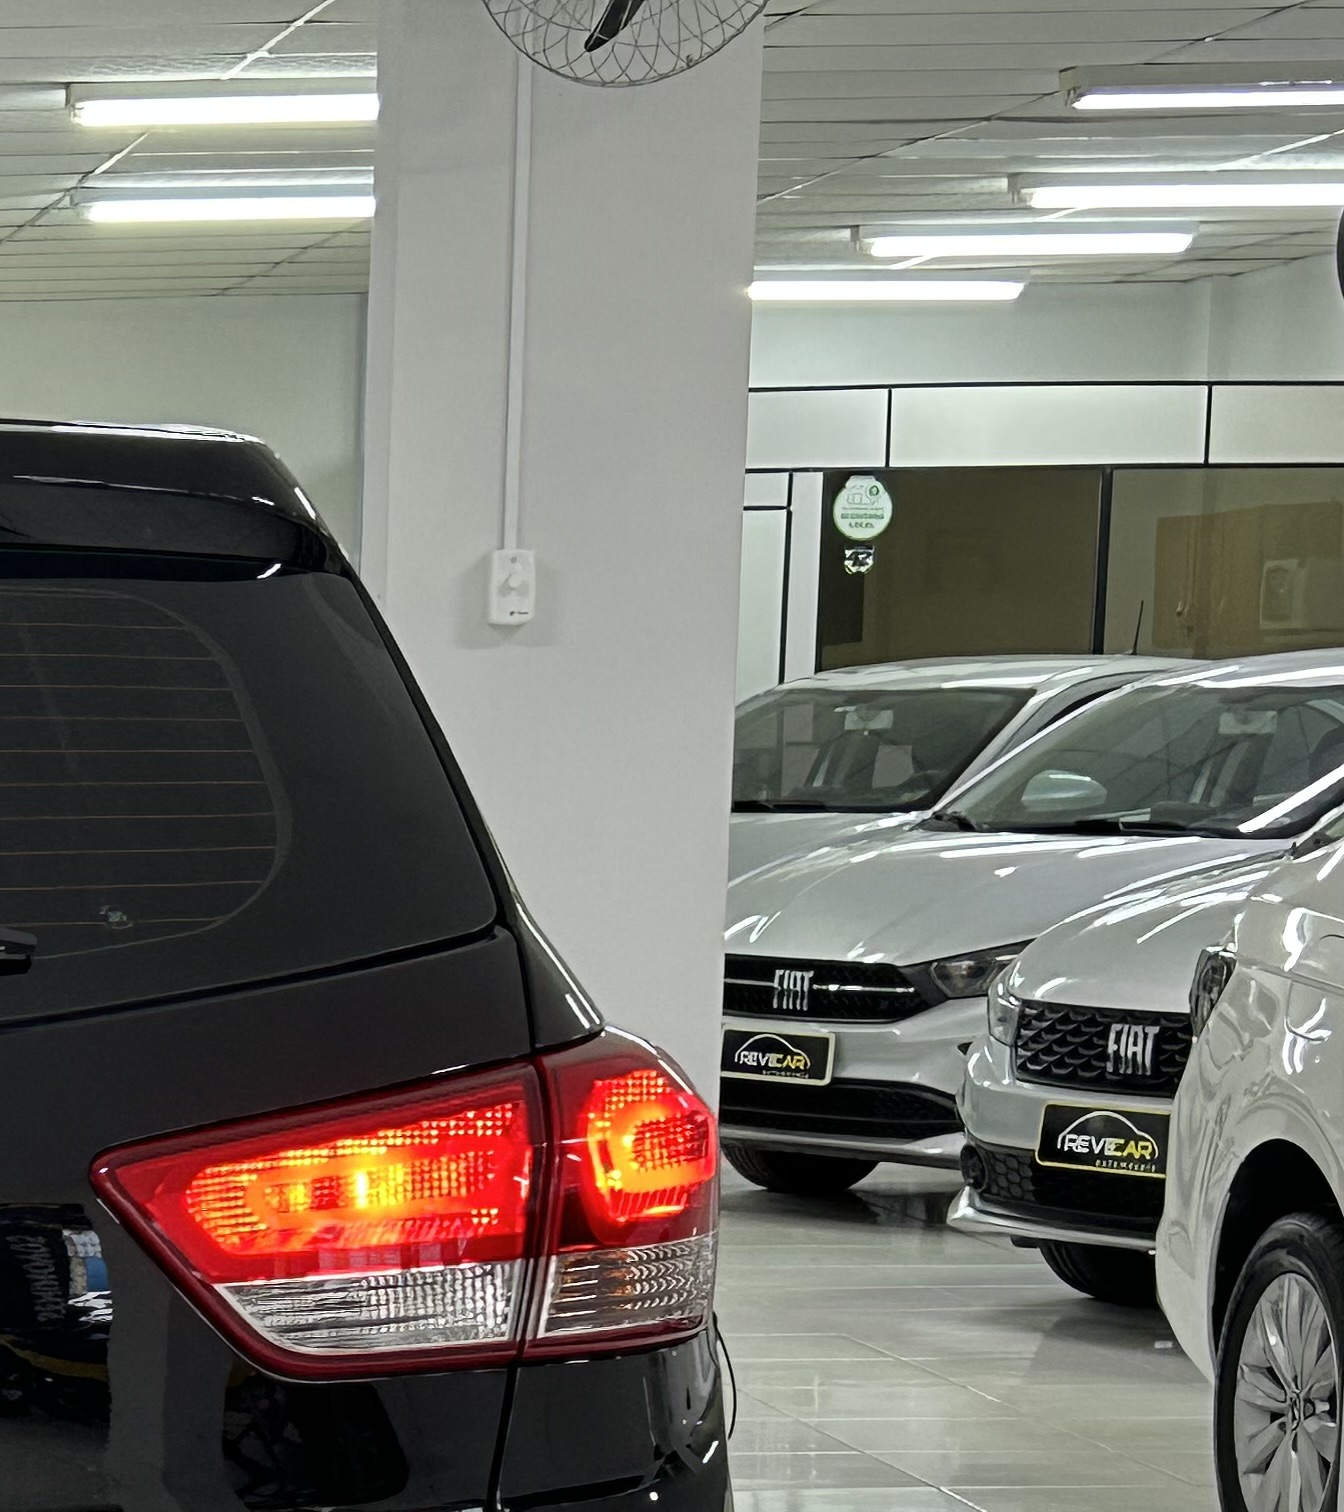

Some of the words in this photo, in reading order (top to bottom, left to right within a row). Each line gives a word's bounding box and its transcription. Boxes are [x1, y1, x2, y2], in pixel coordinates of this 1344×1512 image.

[773, 969, 815, 1012] FIAT
[1106, 1023, 1161, 1076] FIAT
[1063, 1133, 1153, 1160] REVECAR
